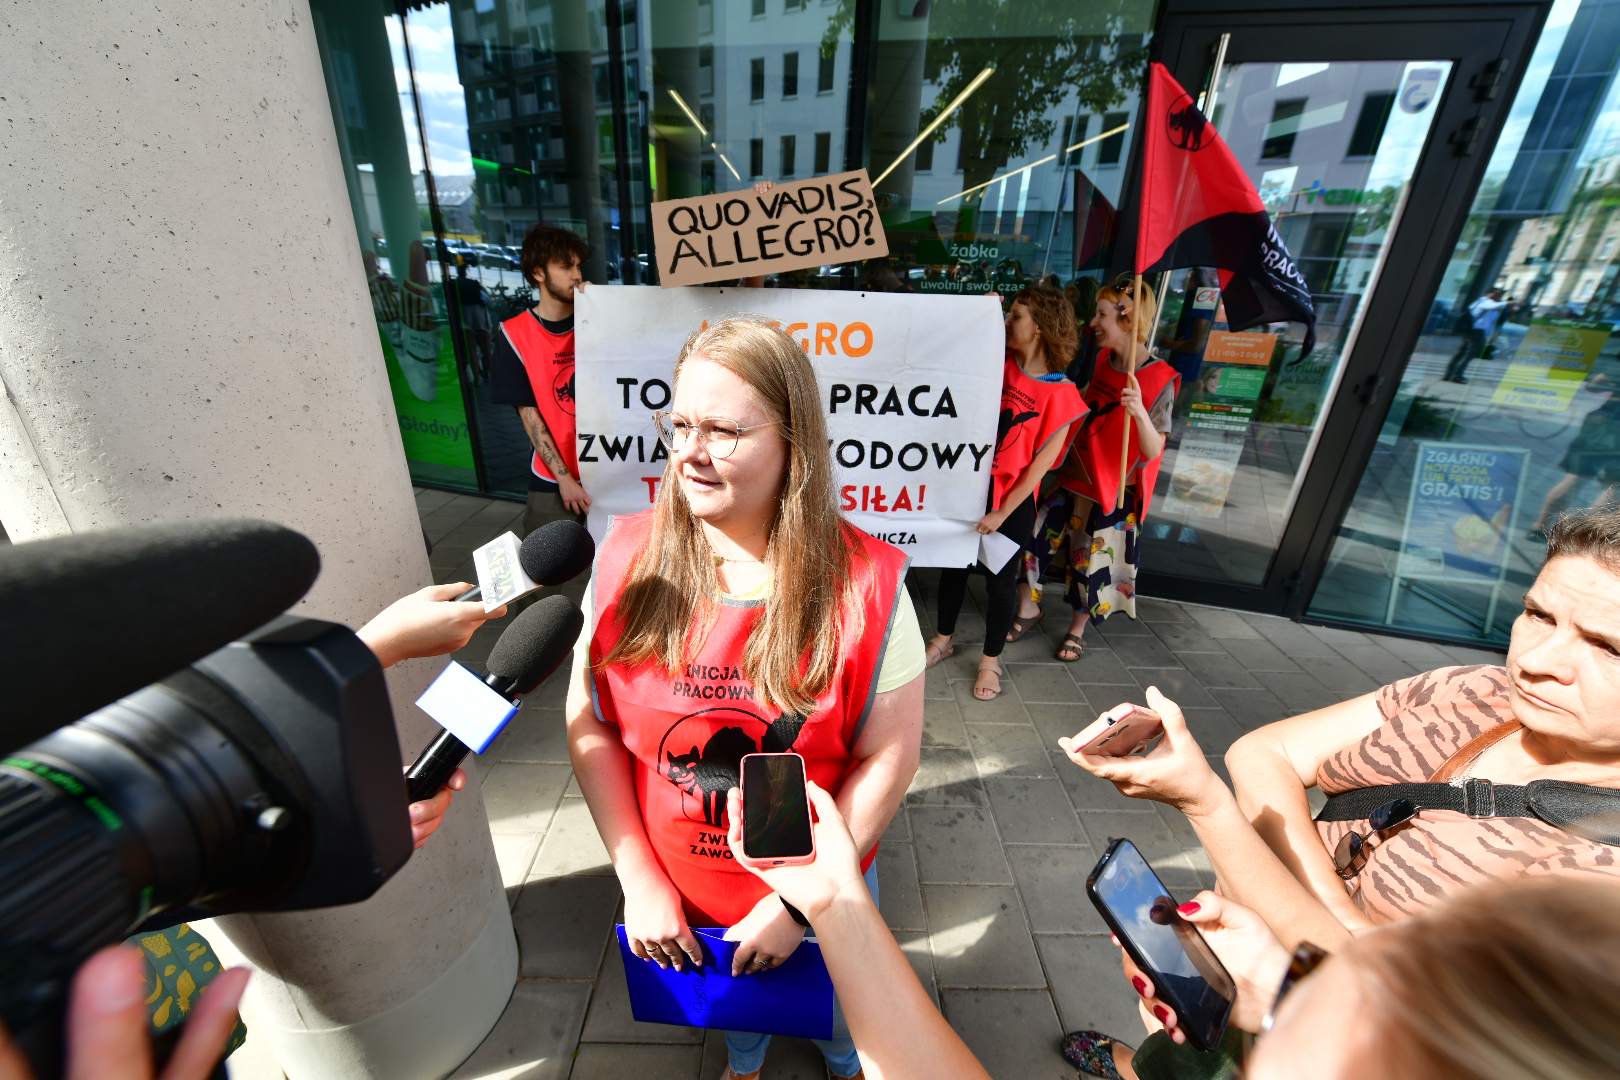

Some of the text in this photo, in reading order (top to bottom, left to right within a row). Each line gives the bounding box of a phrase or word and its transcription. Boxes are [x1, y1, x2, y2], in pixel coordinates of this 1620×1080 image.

[668, 178, 874, 236] QUO VADIS,
[669, 209, 875, 274] ALLEGRO?
[951, 243, 999, 258] żabka
[921, 279, 1026, 292] uwolnij swój czas
[555, 350, 575, 358] INICJA
[616, 378, 958, 418] TO PRACA
[829, 439, 990, 472] ODOWY
[1426, 451, 1497, 466] ZGARNIJ
[1424, 463, 1489, 475] HOT DOGA
[840, 485, 926, 512] SIŁA!
[685, 664, 741, 681] INICJA
[673, 682, 755, 700] PRACOWN
[690, 845, 735, 859] ZAWO
